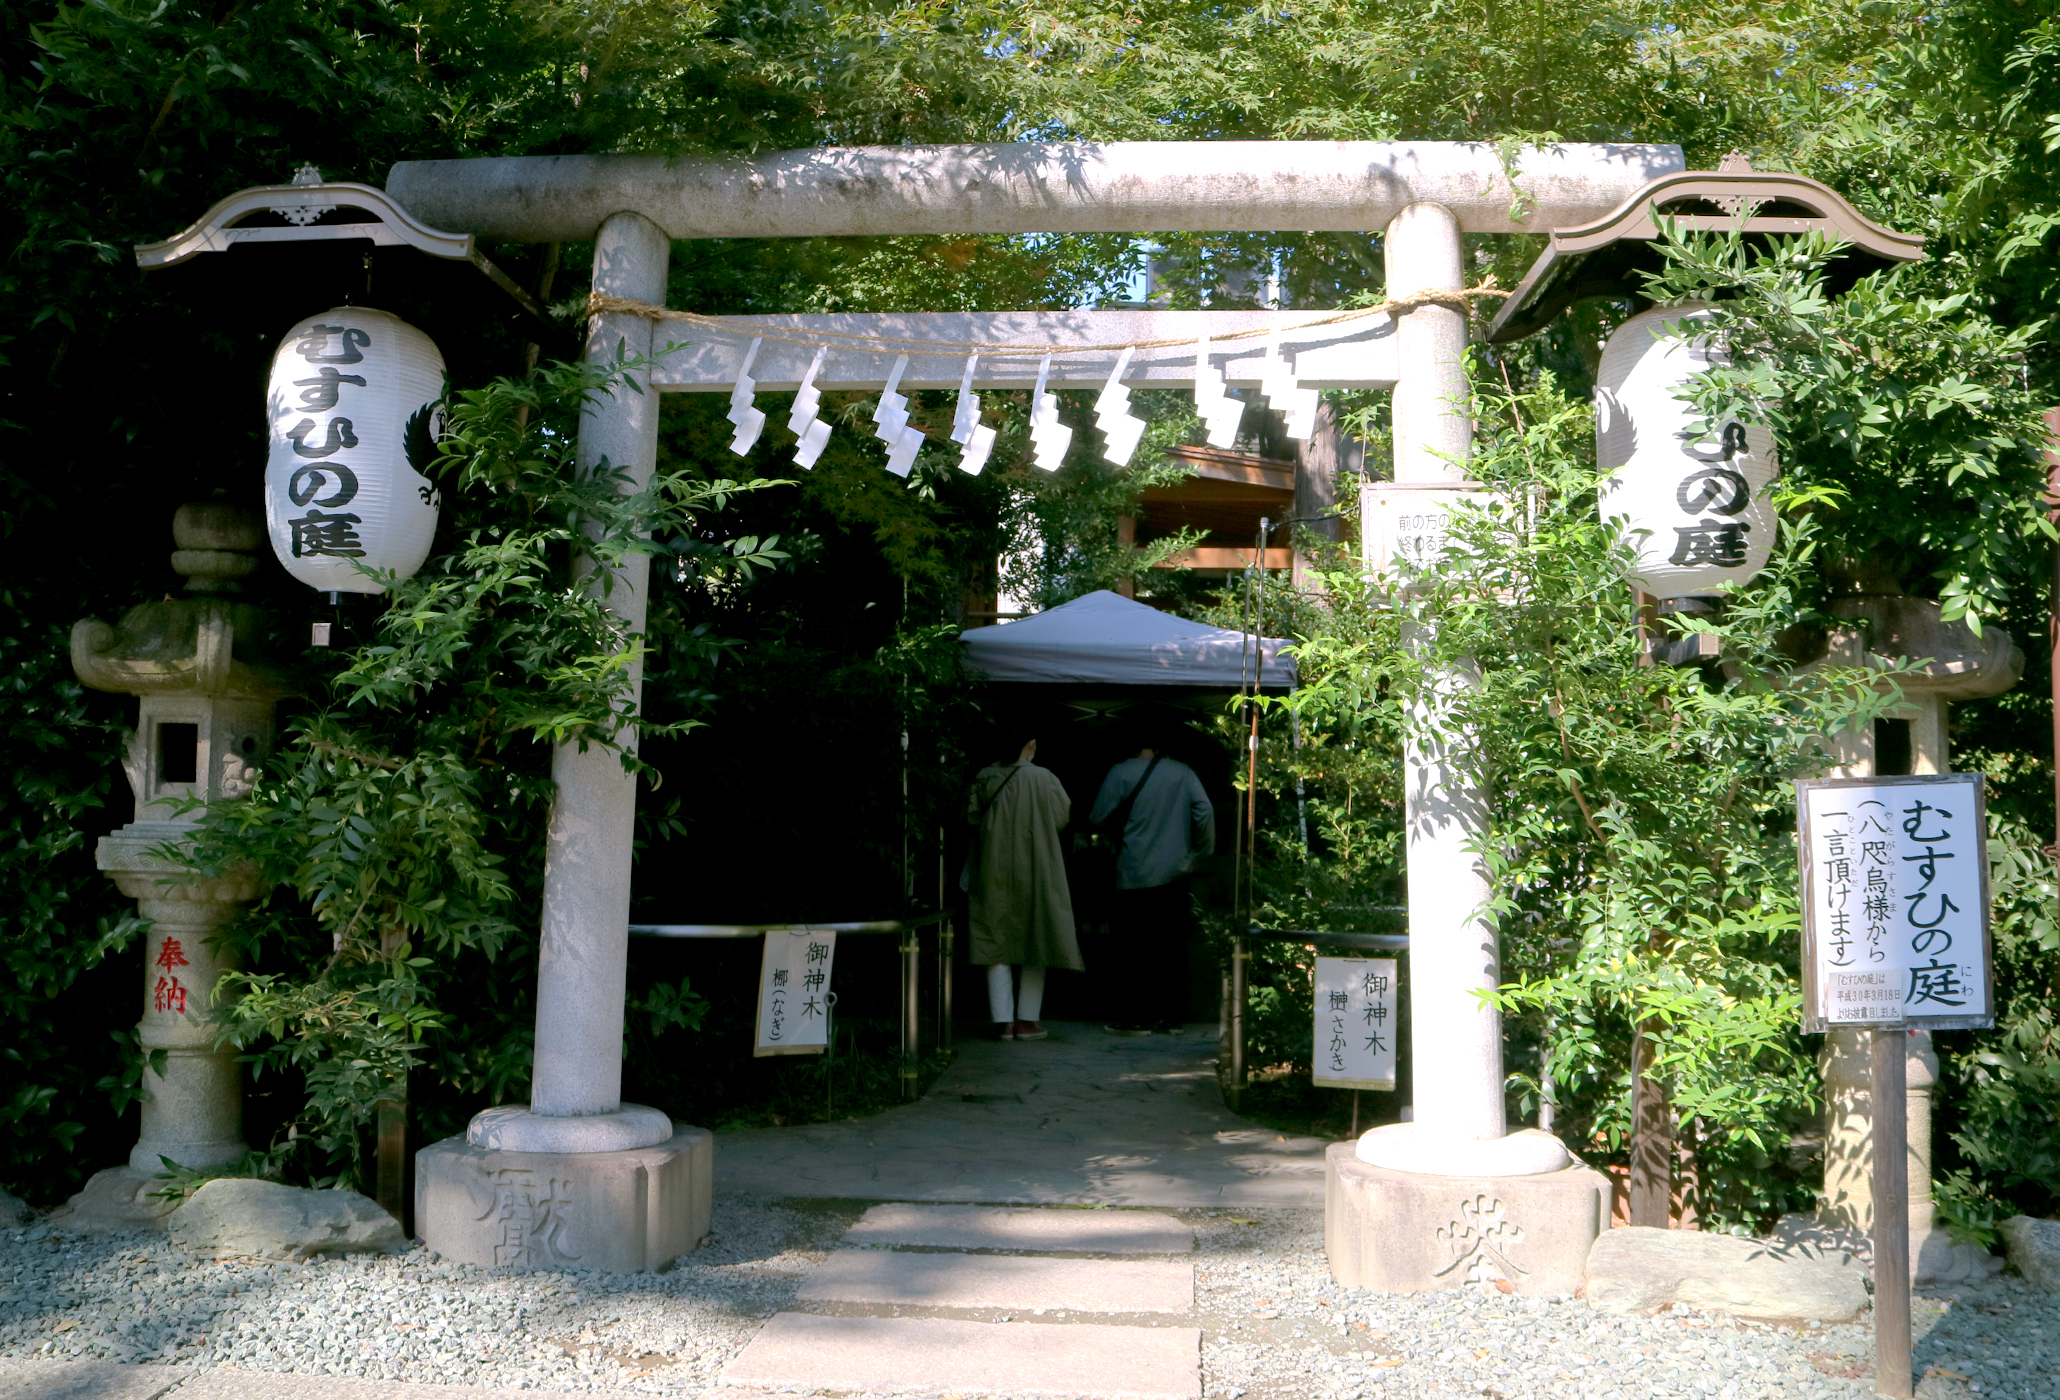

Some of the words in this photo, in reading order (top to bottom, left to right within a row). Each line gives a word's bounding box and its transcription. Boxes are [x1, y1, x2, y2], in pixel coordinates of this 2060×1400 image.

[286, 324, 371, 558] むすひの庭
[1667, 334, 1751, 567] ひの庭
[1820, 811, 1856, 967] 一言頂けます）
[1883, 811, 1898, 913] やたがらすさま
[1902, 800, 1966, 1006] むすひの庭
[154, 935, 191, 1015] 奉納
[801, 941, 829, 1020] 御神木
[1362, 972, 1388, 1056] 御神木
[1836, 989, 1901, 1002] 平成30年3月18日
[1960, 965, 1974, 997] にわ
[1328, 990, 1348, 1072] 榊（さかき）
